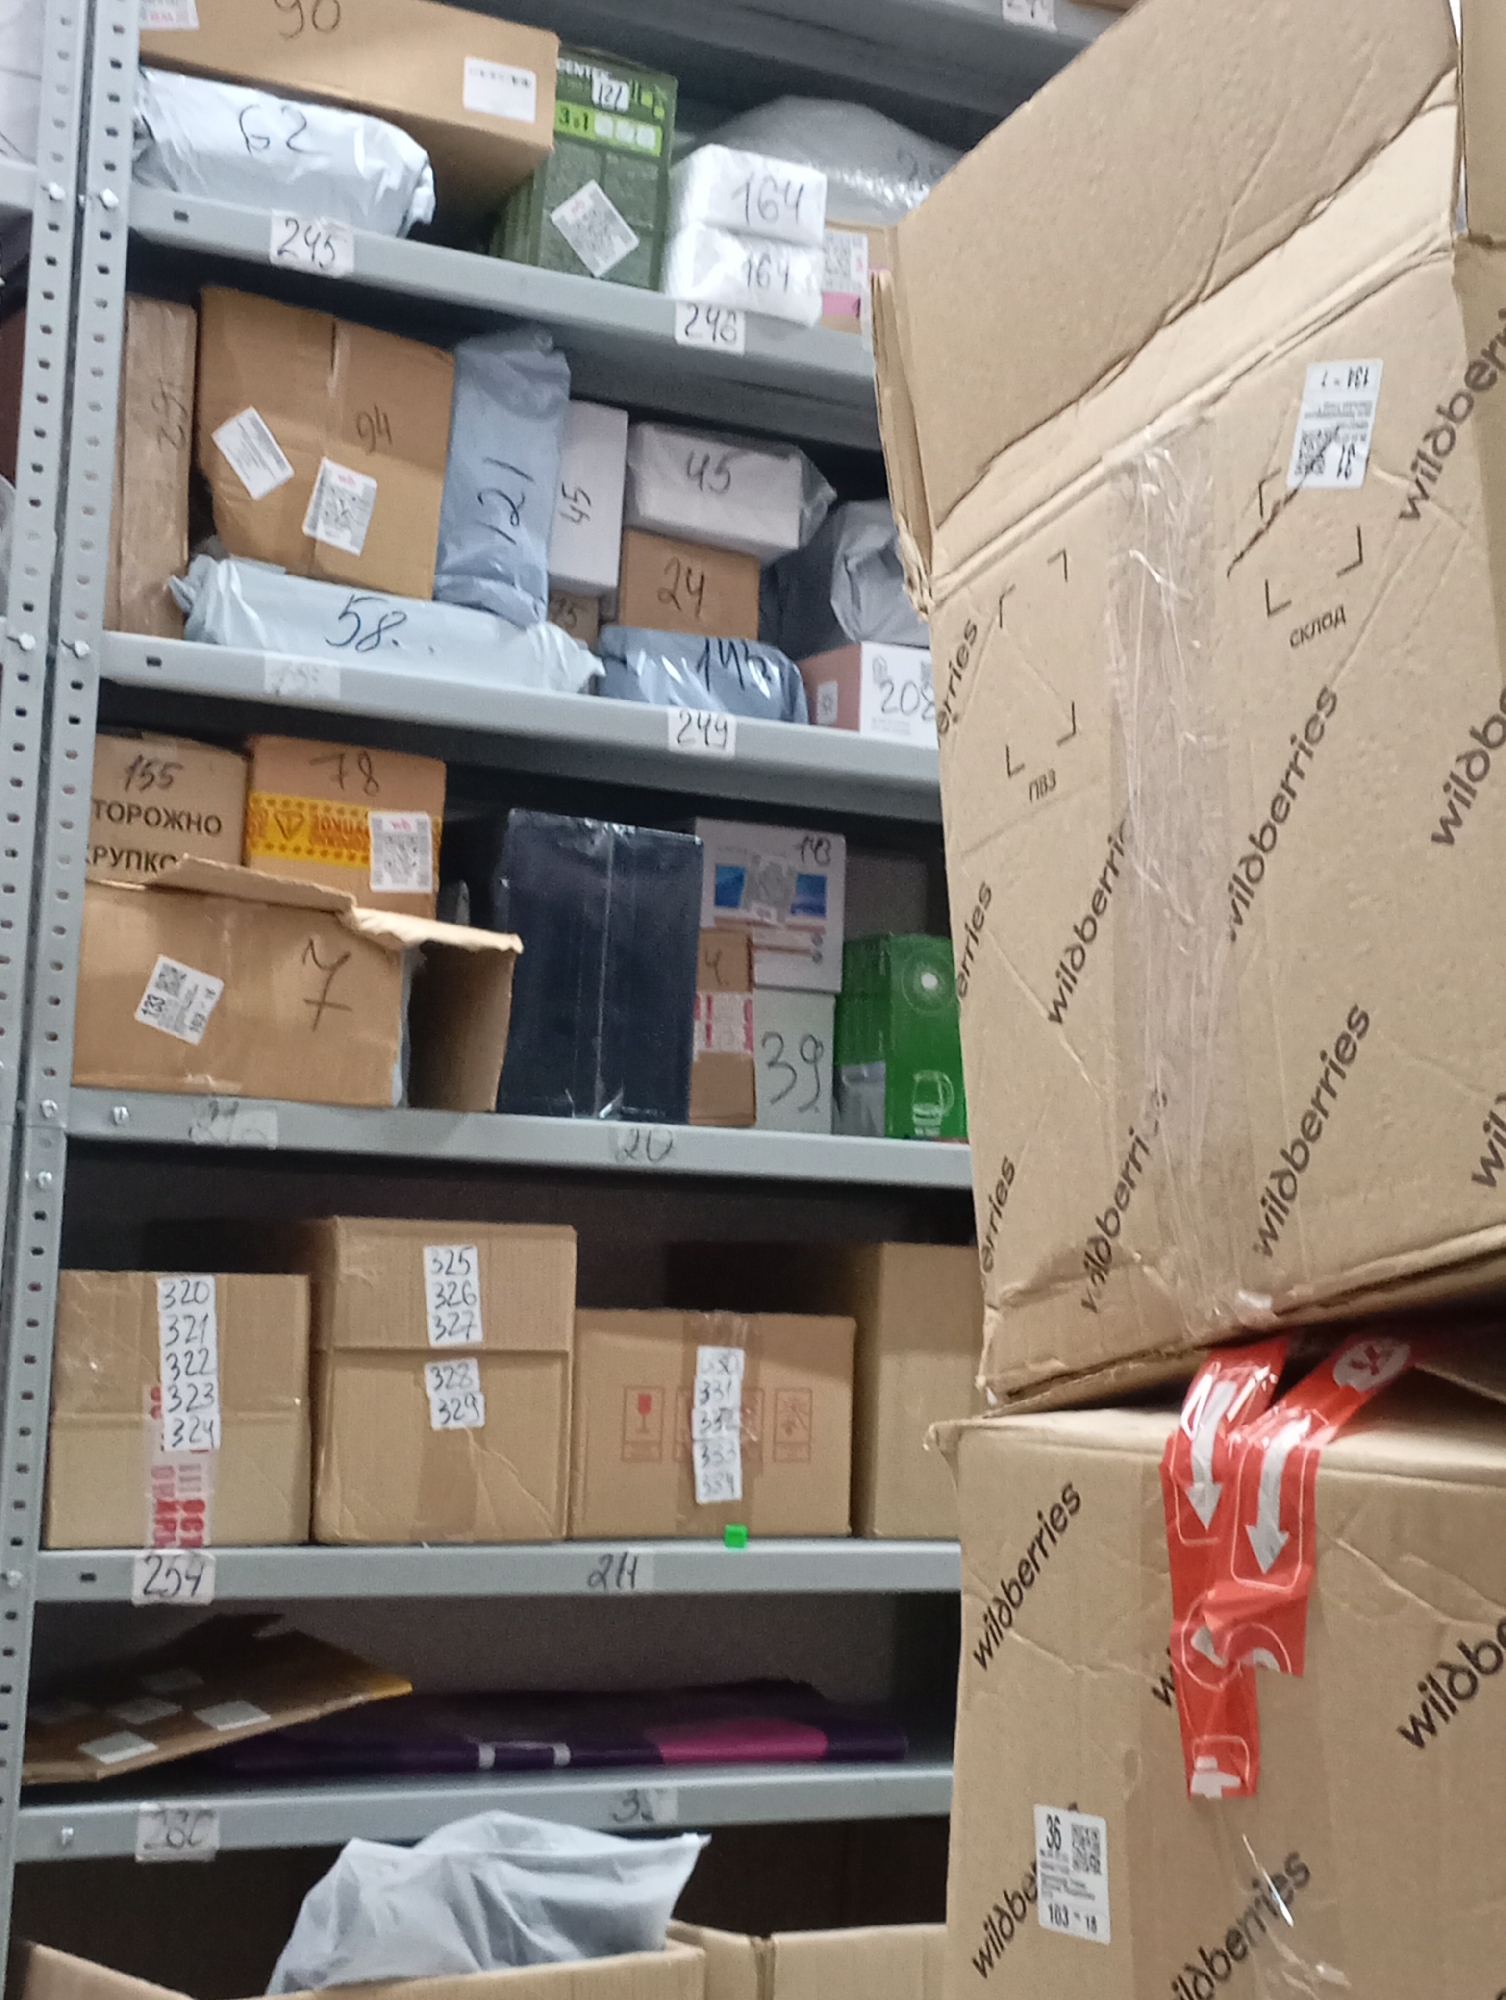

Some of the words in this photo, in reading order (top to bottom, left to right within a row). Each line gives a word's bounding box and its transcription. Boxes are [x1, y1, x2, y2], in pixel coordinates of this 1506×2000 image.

[731, 171, 804, 224] 164
[275, 215, 339, 269] 245
[744, 252, 789, 293] 164
[686, 449, 732, 495] 45
[559, 481, 592, 525] 45
[656, 556, 706, 618] 24
[676, 709, 729, 749] 249
[309, 750, 382, 797] 78
[760, 1030, 825, 1113] 39
[1252, 1003, 1371, 1260] wildberries
[429, 1247, 473, 1276] 325
[161, 1279, 211, 1308] 320
[431, 1281, 477, 1311] 326
[163, 1312, 211, 1346] 321
[433, 1312, 478, 1342] 327
[165, 1348, 213, 1382] 322
[166, 1382, 216, 1413] 323
[437, 1397, 481, 1426] 329
[170, 1416, 215, 1448] 324
[971, 1482, 1082, 1672] wildberries
[1045, 1812, 1062, 1851] 36
[1048, 1902, 1070, 1929] 103
